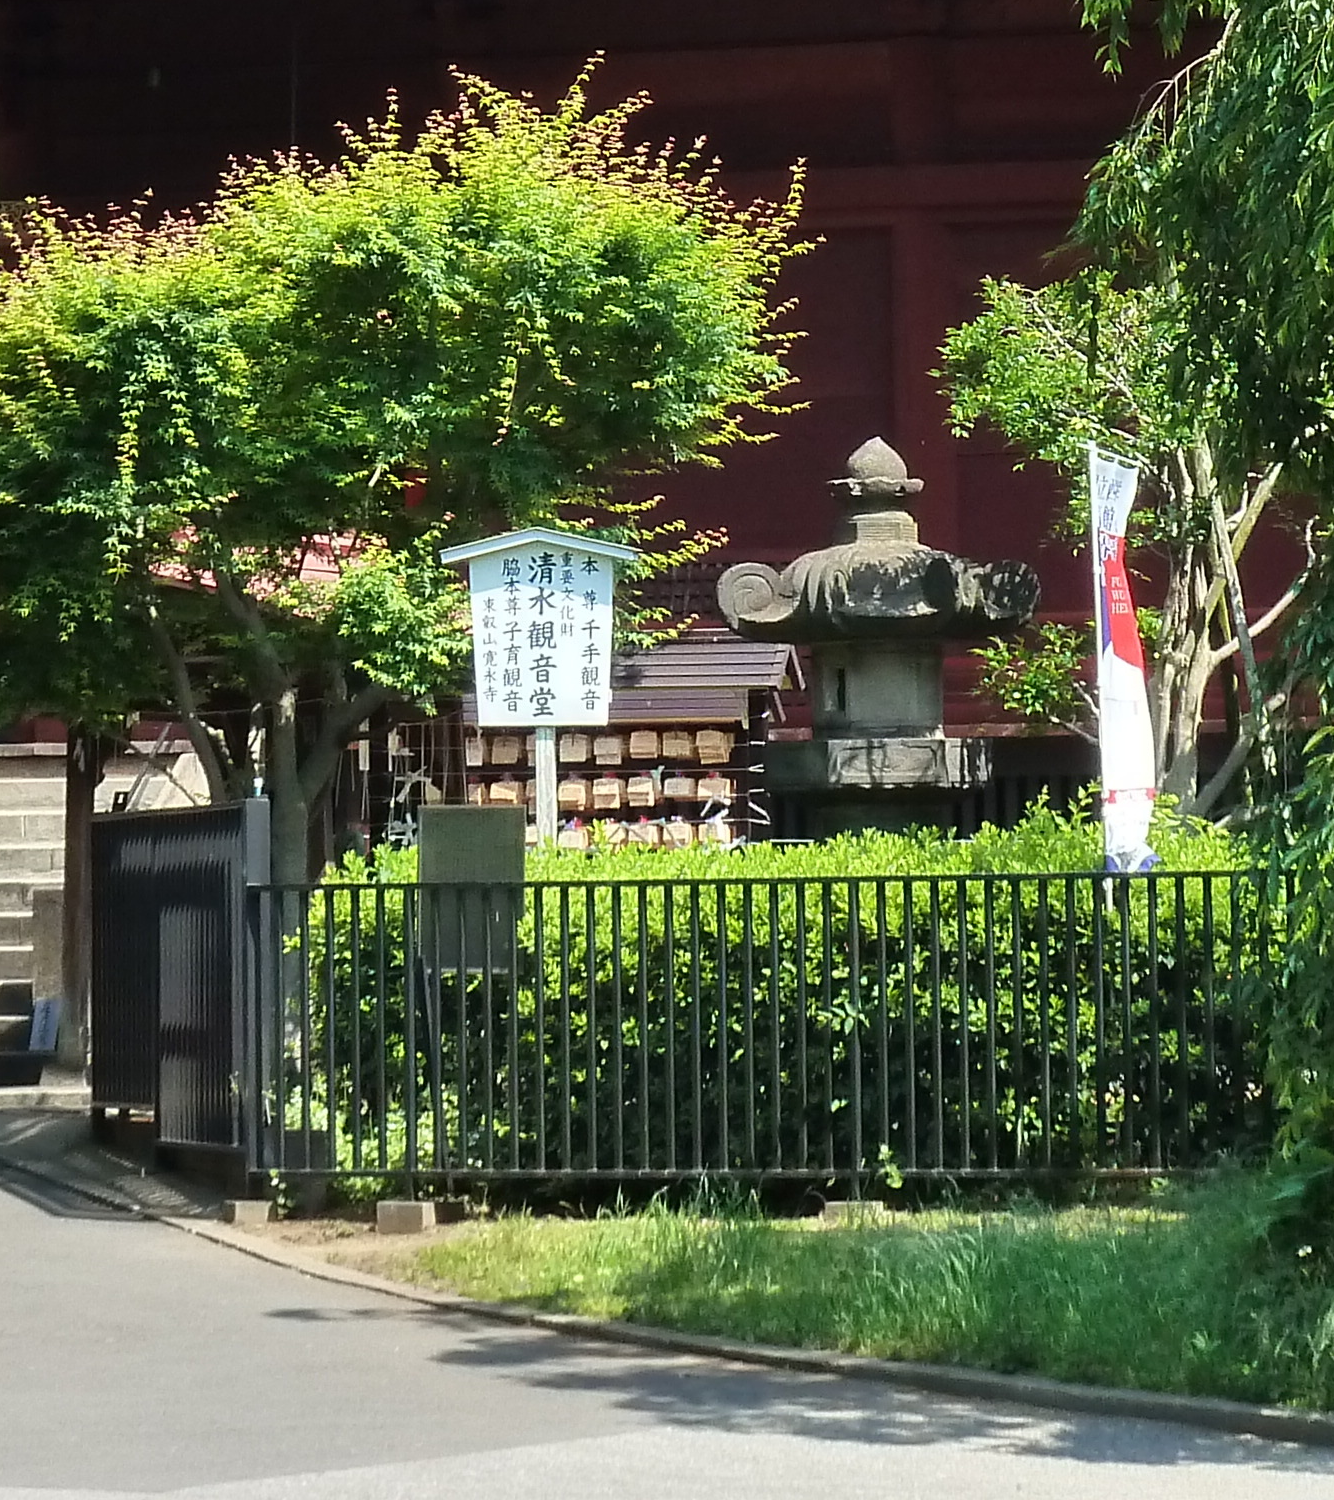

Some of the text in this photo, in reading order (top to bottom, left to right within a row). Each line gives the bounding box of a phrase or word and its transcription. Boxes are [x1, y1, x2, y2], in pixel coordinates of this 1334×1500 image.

[526, 551, 557, 717] 清水観音堂
[560, 551, 575, 637] 重要文化財
[481, 596, 498, 703] 東叡山寛永寺
